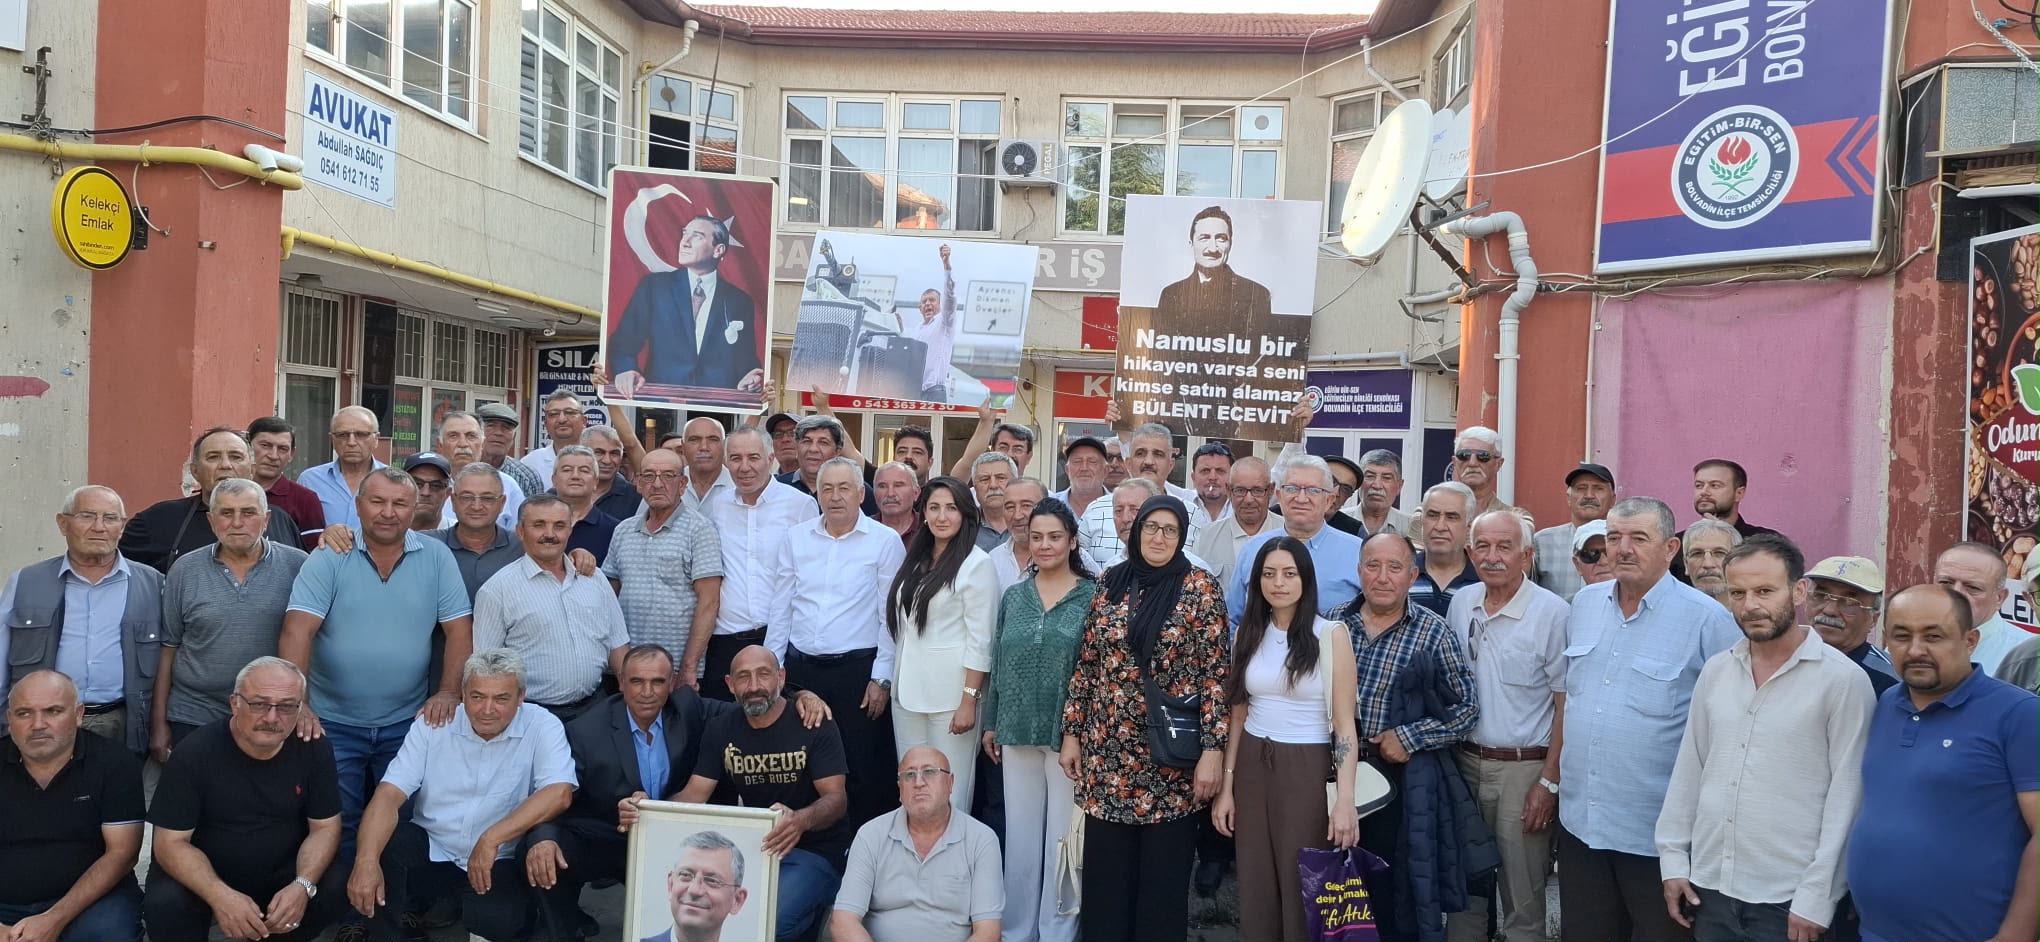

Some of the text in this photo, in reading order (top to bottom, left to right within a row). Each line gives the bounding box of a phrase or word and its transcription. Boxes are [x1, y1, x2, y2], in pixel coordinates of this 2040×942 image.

[1666, 0, 1750, 96] EĞİ
[309, 83, 392, 147] AVUKAT
[318, 130, 384, 173] Abdullah SAĞDIÇ
[320, 157, 379, 193] 0541 612 71 55
[80, 194, 121, 216] Kelekçi
[1685, 181, 1717, 216] BOLVADİN
[81, 214, 114, 231] Emlak
[1136, 329, 1297, 357] Namuslu bir
[1123, 355, 1305, 380] hikayen varsa seni
[1116, 377, 1303, 403] kimse satın alamaz
[852, 399, 861, 407] 0
[865, 400, 889, 408] 543
[893, 401, 916, 409] 363
[919, 402, 936, 410] 22
[1132, 399, 1292, 425] BÜLENT ECEVİT
[1324, 403, 1351, 412] BOLVADİN
[733, 751, 807, 774] BOXEUR
[745, 772, 797, 785] DES RUES
